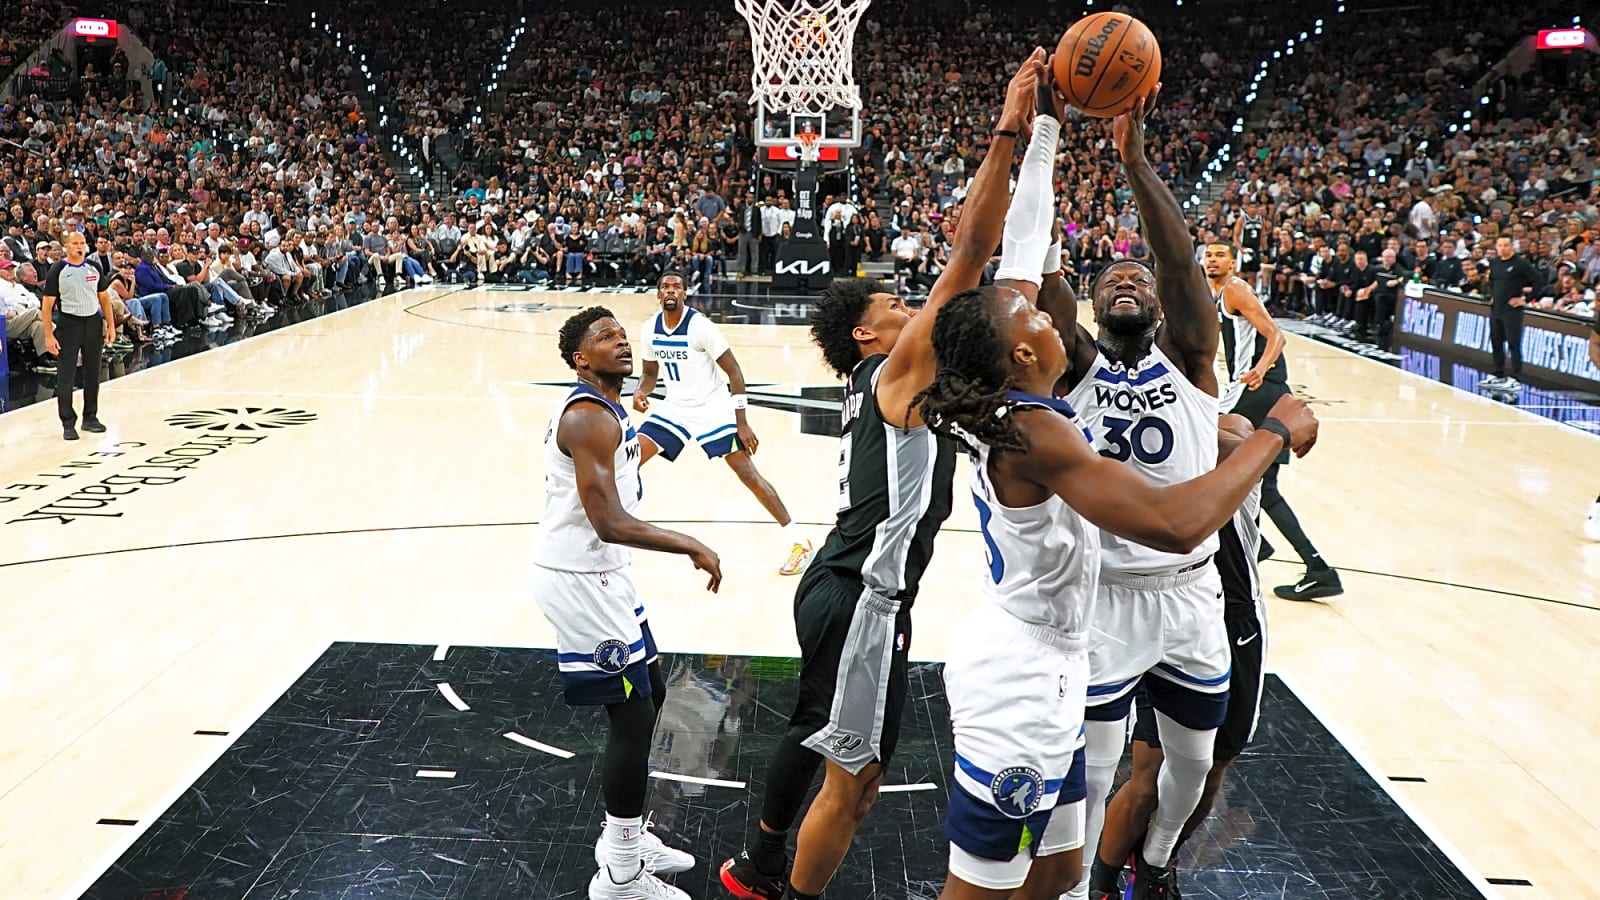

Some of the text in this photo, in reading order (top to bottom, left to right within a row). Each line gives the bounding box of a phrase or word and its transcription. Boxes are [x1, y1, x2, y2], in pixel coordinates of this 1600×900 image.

[1075, 18, 1122, 77] Wilson
[1454, 311, 1484, 349] BUILD
[655, 350, 688, 360] WOLVES
[664, 361, 681, 382] 11
[1098, 415, 1174, 465] 30
[5, 434, 268, 525] Frost Bank
